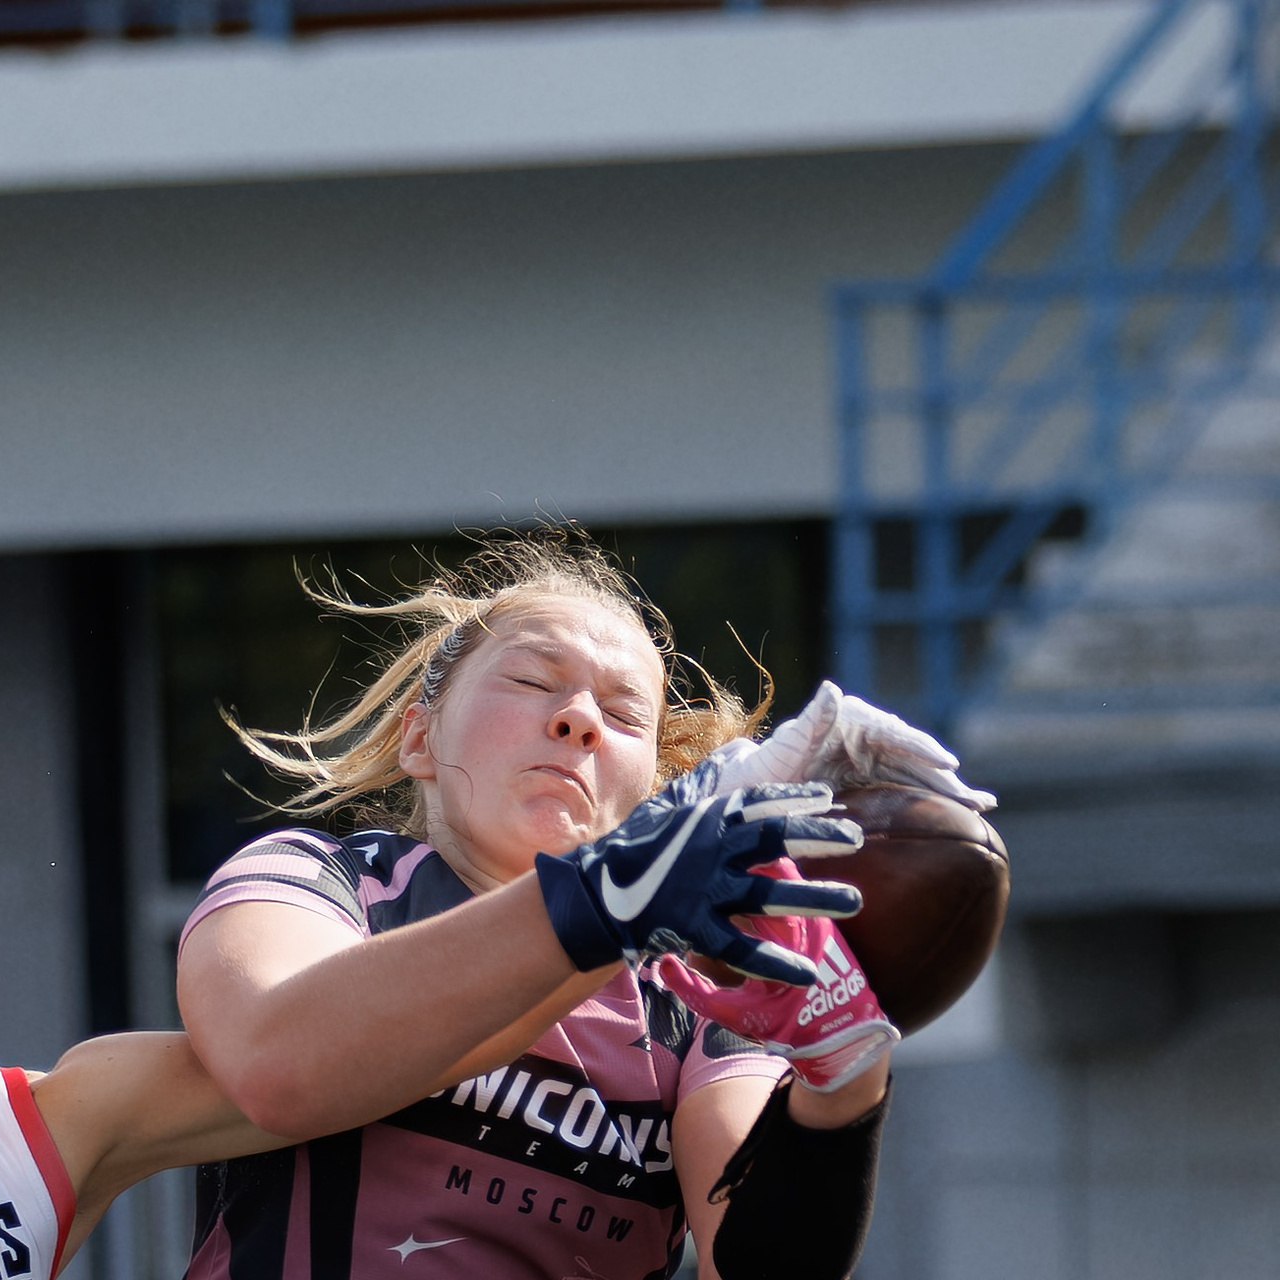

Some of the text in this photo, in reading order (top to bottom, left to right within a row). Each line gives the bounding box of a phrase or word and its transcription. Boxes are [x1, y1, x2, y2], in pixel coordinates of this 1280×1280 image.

[797, 968, 866, 1027] adidas
[477, 1124, 636, 1189] TEAM
[445, 1165, 634, 1242] MOSCOW
